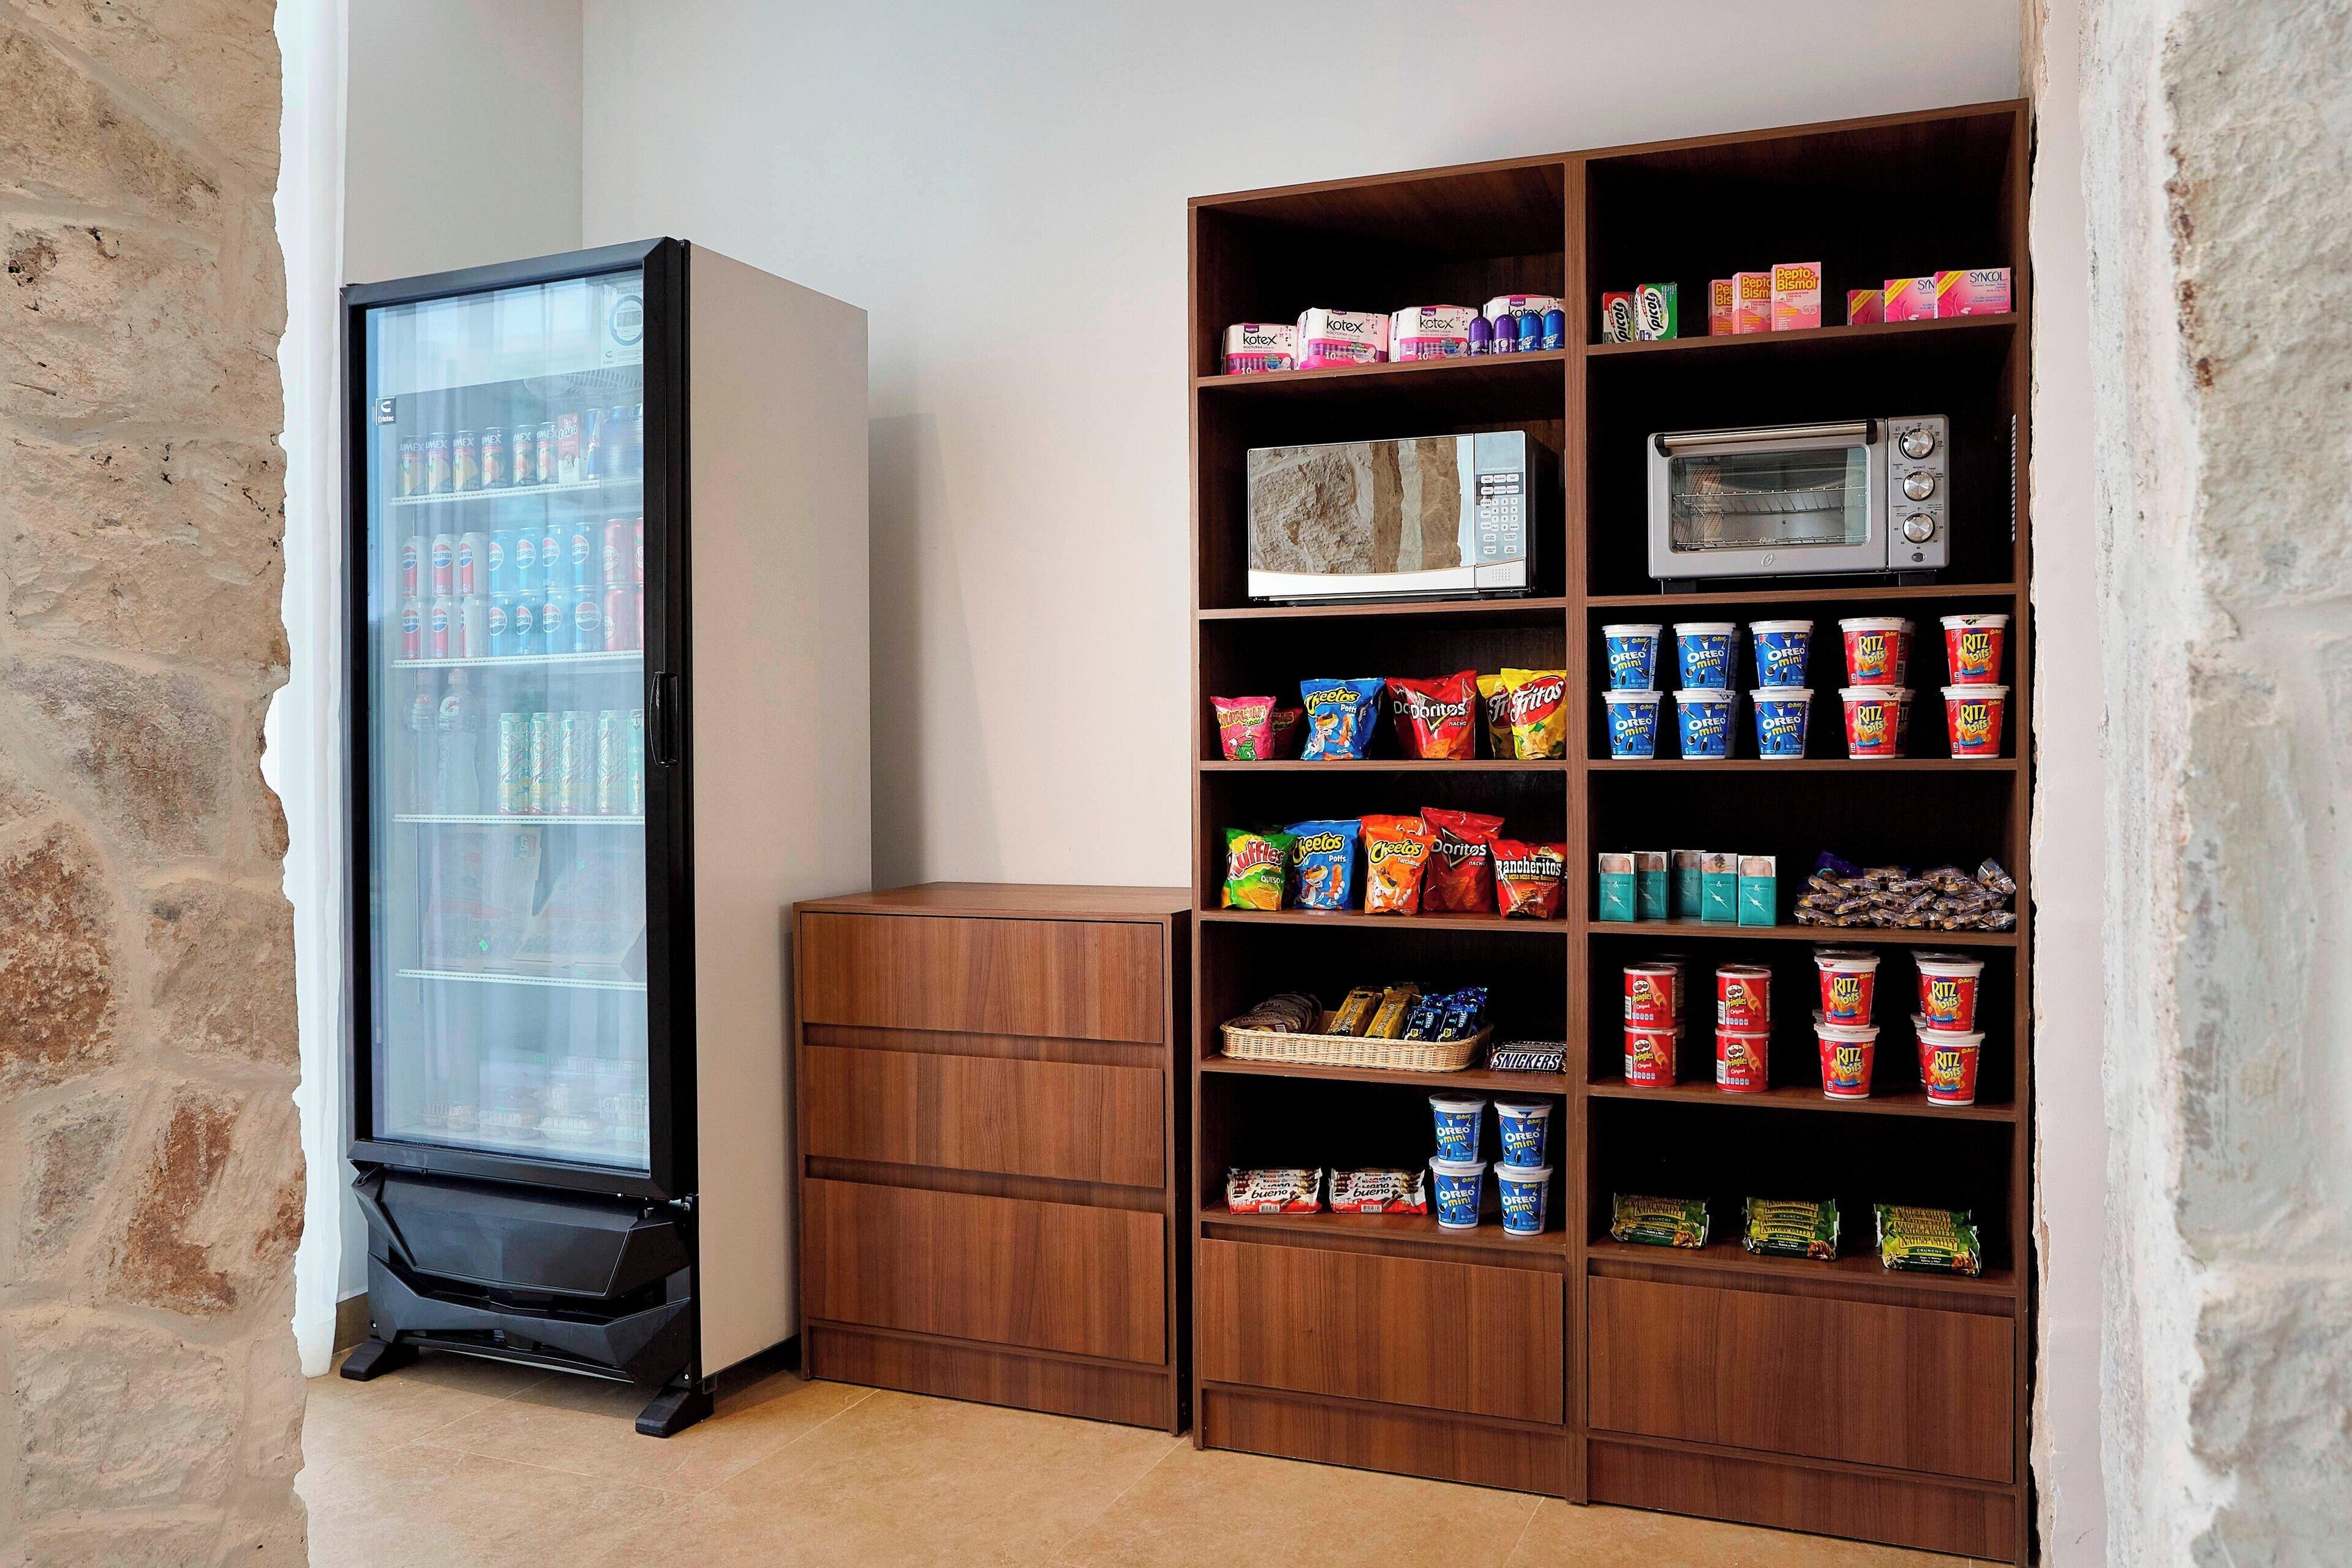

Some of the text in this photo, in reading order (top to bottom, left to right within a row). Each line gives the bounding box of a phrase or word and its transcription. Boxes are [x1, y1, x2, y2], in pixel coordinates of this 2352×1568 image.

[1777, 267, 1814, 279] Pepto-
[1970, 271, 2003, 283] SYNCOL
[1777, 279, 1817, 291] Bismol
[1327, 315, 1364, 334] kotex
[1420, 315, 1454, 329] kotex
[1243, 332, 1278, 345] kotex
[1859, 635, 1884, 656] RITZ
[1963, 633, 1988, 654] RITZ
[1610, 652, 1646, 665] OREO
[1687, 650, 1724, 663] OREO
[1768, 647, 1804, 662] OREO
[1779, 655, 1801, 667] mini
[1865, 650, 1885, 664] bits
[1969, 648, 1990, 662] bits
[1618, 659, 1642, 670] mini
[1697, 657, 1720, 669] mini
[440, 696, 459, 716] G
[1305, 688, 1359, 716] Cheetos
[1510, 681, 1564, 723] Fritos
[1411, 701, 1467, 719] Doritos
[1858, 706, 1883, 725] RITZ
[1961, 704, 1986, 724] RITZ
[1615, 718, 1652, 731] OREO
[1688, 717, 1726, 730] OREO
[1762, 716, 1801, 730] OREO
[1864, 720, 1884, 734] bits
[1968, 719, 1989, 733] bits
[1625, 726, 1648, 737] mini
[1699, 725, 1722, 736] mini
[1771, 725, 1797, 736] mini
[1293, 834, 1343, 864] Cheetos
[1370, 840, 1423, 864] Cheetos
[1431, 839, 1487, 858] Doritos
[1226, 839, 1286, 879] Ruffles
[1496, 856, 1562, 880] Rancheritos
[1261, 875, 1281, 884] QUESO
[1834, 977, 1858, 996] RITZ
[1932, 981, 1956, 1000] RITZ
[1632, 992, 1653, 1005] Pringles
[1725, 997, 1746, 1010] Pringles
[1841, 992, 1860, 1005] bits
[1938, 997, 1958, 1009] bits
[1495, 1052, 1561, 1069] SNICKERS
[1634, 1052, 1654, 1064] Pringles
[1836, 1047, 1861, 1065] RITZ
[1935, 1050, 1960, 1070] RITZ
[1726, 1058, 1747, 1070] Pringles
[1842, 1062, 1862, 1076] bits
[1942, 1067, 1962, 1079] bits
[1437, 1126, 1470, 1137] OREO
[1444, 1133, 1466, 1143] mini
[1505, 1131, 1540, 1142] OREO
[1513, 1139, 1536, 1149] mini
[1251, 1190, 1287, 1199] bueno
[1354, 1188, 1390, 1197] bueno
[1439, 1189, 1474, 1200] OREO
[1448, 1196, 1471, 1207] mini
[1502, 1195, 1537, 1205] OREO
[1510, 1203, 1532, 1213] mini
[1662, 1208, 1684, 1218] VALLEY
[1788, 1227, 1814, 1237] VALLEY
